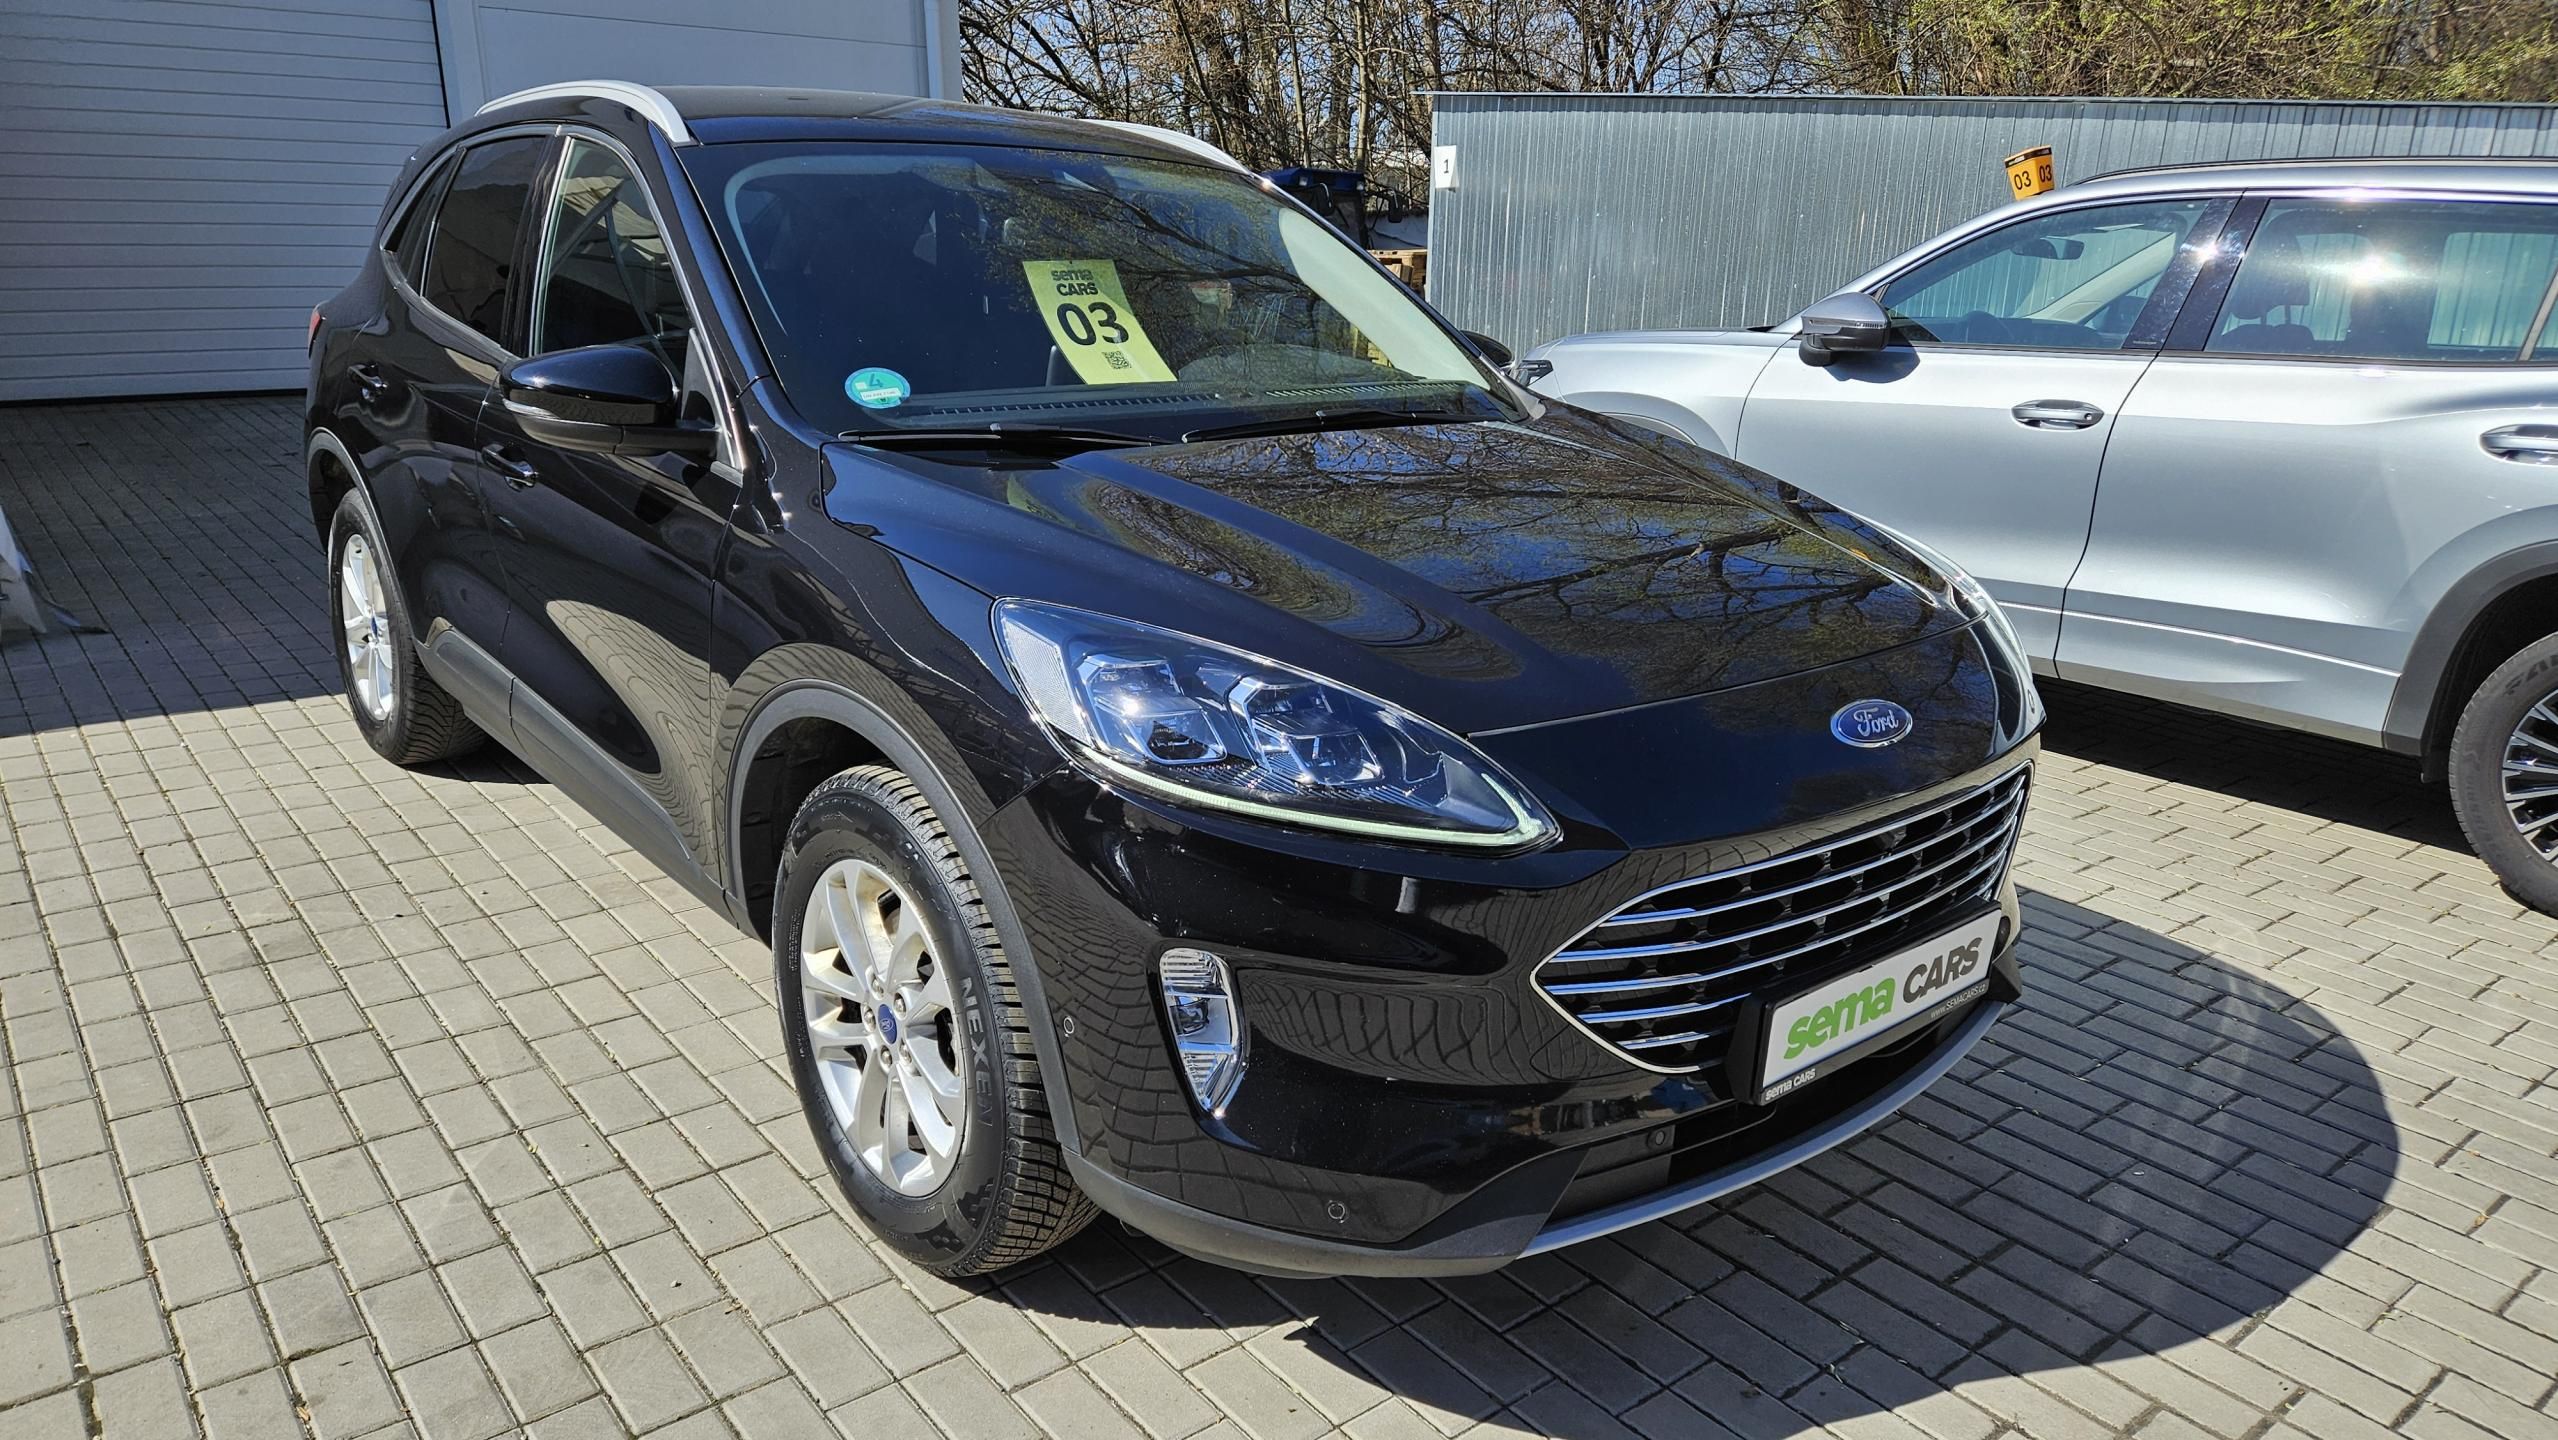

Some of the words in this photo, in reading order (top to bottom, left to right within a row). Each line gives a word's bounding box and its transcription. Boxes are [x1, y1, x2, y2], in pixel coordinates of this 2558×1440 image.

[1443, 158, 1449, 174] 1
[2038, 164, 2052, 183] 03
[2013, 170, 2032, 191] 03
[1051, 269, 1094, 281] sema
[1056, 282, 1099, 296] CARS
[1056, 301, 1129, 346] 03
[869, 373, 883, 387] 4
[1853, 706, 1899, 737] Ford
[1783, 977, 1896, 1060] sema
[1902, 937, 1983, 1004] CARS
[959, 977, 993, 1127] NEXEN
[1765, 1079, 1793, 1101] sema
[1793, 1068, 1816, 1087] CARS
